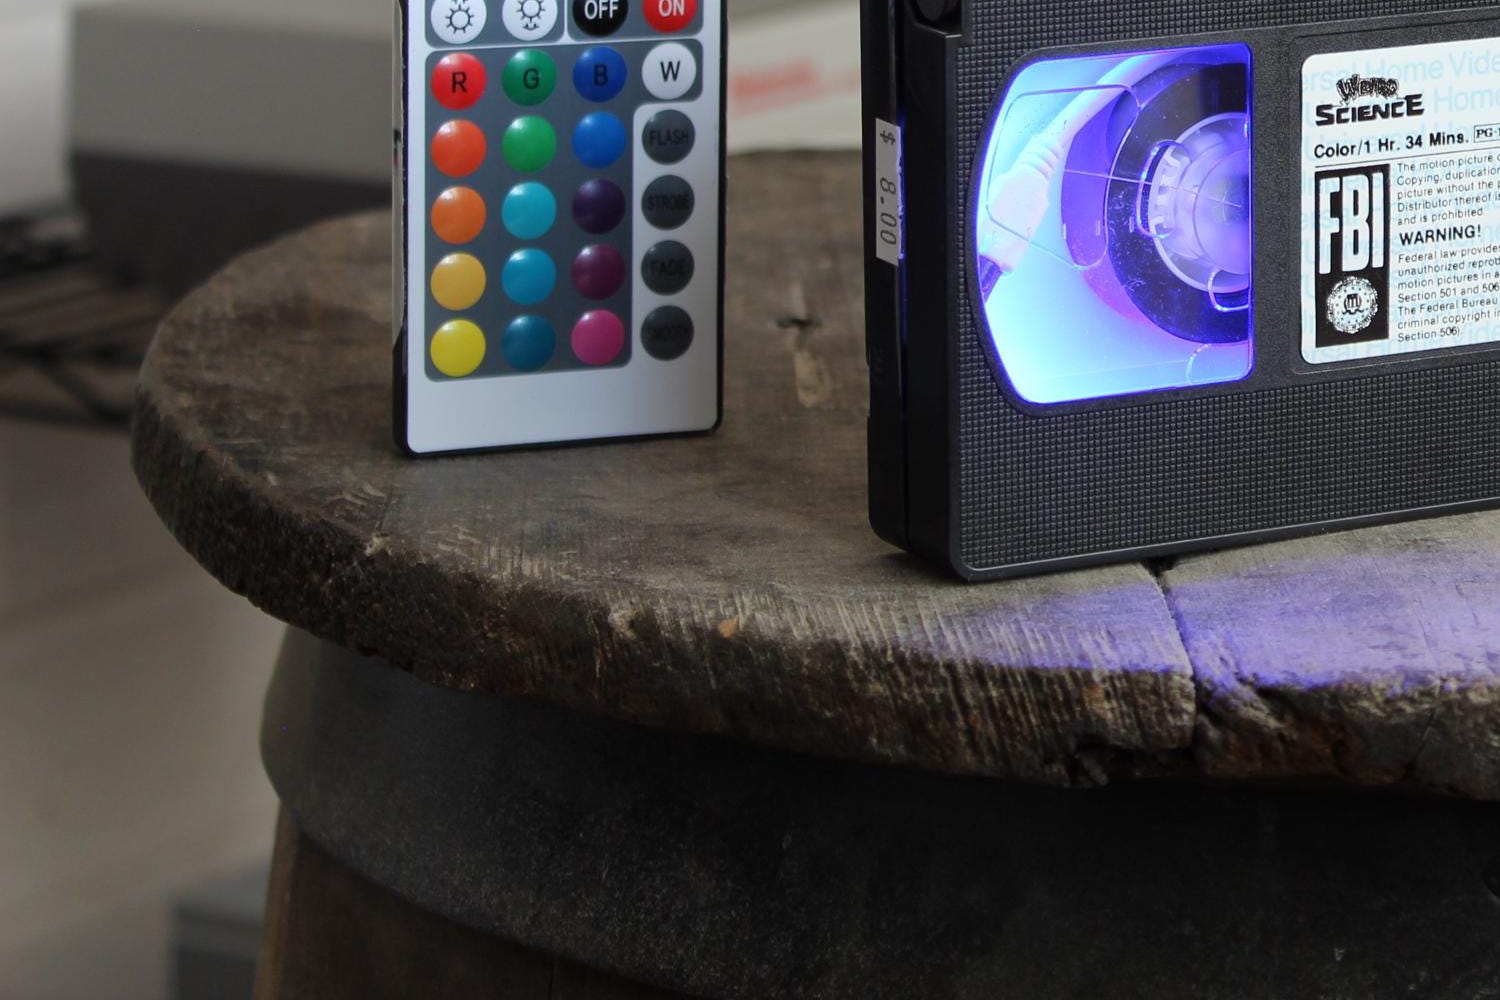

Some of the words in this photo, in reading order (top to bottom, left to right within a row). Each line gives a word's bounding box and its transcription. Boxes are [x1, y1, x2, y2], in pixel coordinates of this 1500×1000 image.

[523, 68, 540, 90] G
[593, 64, 608, 87] B
[660, 60, 681, 82] W
[452, 72, 467, 93] R
[1315, 94, 1425, 126] SCIENCE
[649, 127, 689, 146] FLASH
[880, 129, 896, 146] $
[1314, 140, 1370, 159] Color/1
[1378, 137, 1400, 152] Hr.
[1406, 134, 1423, 150] 34
[1429, 131, 1469, 147] Mins.
[1397, 162, 1416, 173] The
[1419, 159, 1455, 170] motion
[1458, 154, 1494, 167] picture
[1396, 174, 1442, 187] Copying,
[1397, 188, 1433, 201] picture
[1436, 181, 1474, 195] without
[1477, 180, 1494, 190] the
[880, 177, 897, 245] 8.00
[1397, 198, 1452, 213] Distributor
[1454, 192, 1492, 206] thereof
[1319, 172, 1384, 275] FBI
[1397, 214, 1417, 226] and
[1419, 214, 1428, 223] is
[1399, 224, 1481, 247] WARNING!
[651, 257, 687, 276] FADE
[1398, 250, 1437, 264] Federal
[1440, 249, 1457, 259] law
[1397, 260, 1465, 277] unauthorized
[1397, 278, 1434, 290] motion
[1437, 273, 1479, 287] pictures
[1481, 271, 1491, 279] in
[1397, 291, 1437, 304] Section
[1439, 287, 1457, 299] 501
[1460, 284, 1479, 296] and
[1397, 305, 1417, 316] The
[1419, 300, 1459, 313] Federal
[1461, 297, 1498, 309] Bureau
[1397, 315, 1439, 330] criminal
[1442, 310, 1491, 325] copyright
[1397, 330, 1437, 343] Section
